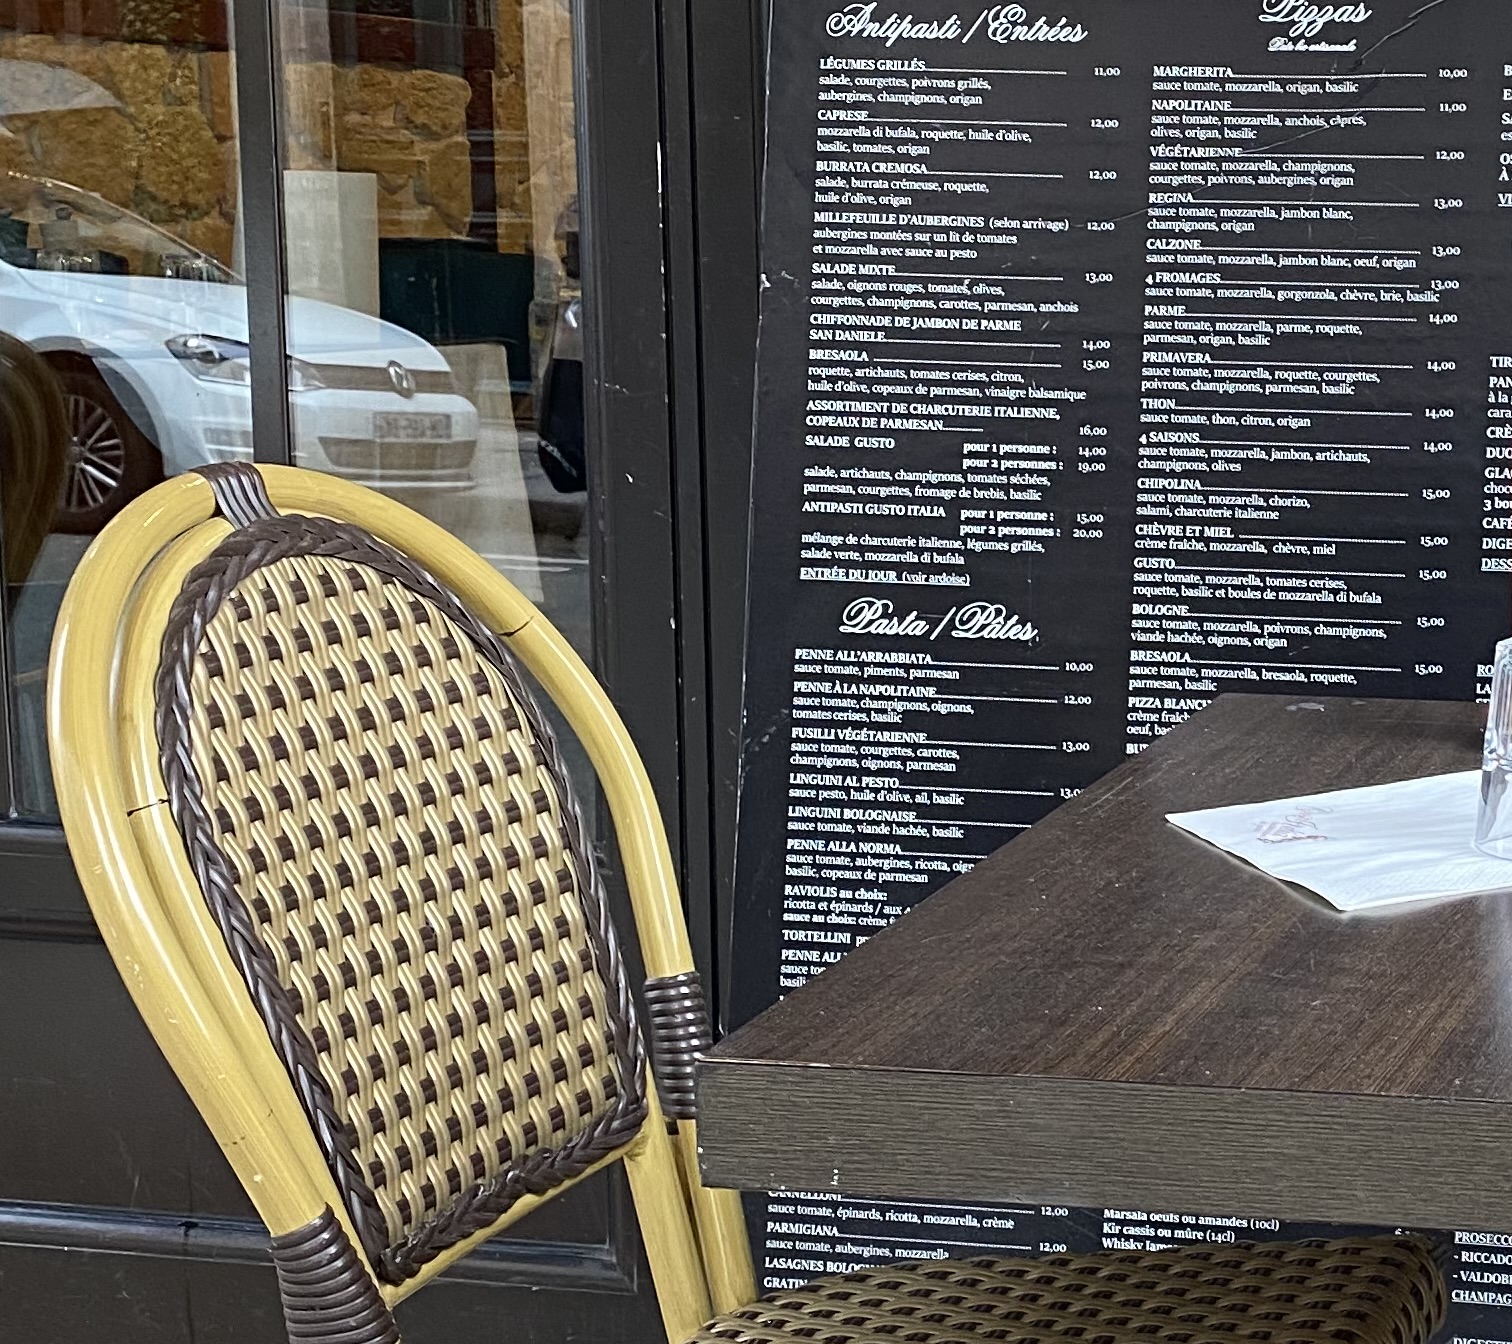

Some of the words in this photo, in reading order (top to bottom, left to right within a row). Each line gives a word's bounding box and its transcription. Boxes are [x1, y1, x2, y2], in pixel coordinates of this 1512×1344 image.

[826, 2, 961, 47] Antipasti
[987, 4, 1088, 43] Entrées
[820, 57, 875, 70] LÉGUMES
[877, 58, 925, 70] GRILLÉS
[1094, 67, 1120, 77] 11,00
[1153, 66, 1233, 77] MARGHERITA
[1439, 69, 1467, 79] 10,00
[819, 76, 853, 87] salade,
[855, 76, 909, 89] courgettes,
[912, 78, 955, 89] poivrons
[958, 78, 991, 90] grillés,
[1153, 82, 1181, 91] sauce
[1184, 80, 1222, 93] tomate,
[1225, 81, 1283, 94] mozzarella,
[1286, 82, 1322, 95] origan,
[1326, 82, 1358, 92] basilic
[1152, 100, 1231, 111] NAPOLITAINE
[1439, 103, 1467, 113] 11,00
[818, 110, 869, 120] CAPRESE
[1091, 119, 1118, 128] 12,00
[1150, 146, 1242, 157] VÉGÉTARIENNE
[1435, 151, 1464, 161] 12,00
[816, 161, 870, 173] BURRATA
[872, 163, 927, 174] CREMOSA
[1089, 170, 1116, 180] 12,00
[1149, 193, 1193, 203] REGINA
[1434, 198, 1462, 209] 13,00
[814, 212, 896, 224] MILLEFEUILLE
[899, 214, 984, 227] D'AUBERGINES
[989, 218, 1020, 229] (selon
[1022, 219, 1069, 232] arrivage)
[1147, 240, 1201, 250] CALZONE
[1432, 246, 1460, 257] 13,00
[812, 263, 856, 275] SALADE
[859, 264, 896, 275] MIXTE
[1145, 274, 1153, 286] 4
[1156, 273, 1221, 284] FROMAGES
[1139, 434, 1147, 445] 4
[1150, 432, 1200, 443] SAISONS
[1424, 441, 1452, 453] 14,00
[1137, 478, 1201, 489] CHIPOLINA
[1422, 488, 1450, 499] 15,00
[1134, 558, 1175, 569] GUSTO
[1419, 570, 1447, 580] 15,00
[839, 597, 929, 636] Pasta
[952, 602, 1038, 641] Pâtes
[795, 649, 833, 661] PENNE
[836, 650, 932, 665] ALL'ARRABBIATA
[1065, 662, 1093, 673] 10,00
[1130, 651, 1191, 662] BRESAOLA
[790, 774, 842, 786] LINGUINI
[844, 775, 859, 787] AL
[862, 776, 899, 788] PESTO
[785, 885, 837, 898] RAVIOLIS
[839, 889, 852, 899] au
[855, 887, 887, 900] choix:
[783, 930, 851, 944] TORTELLINI
[767, 1221, 838, 1237] PARMIGIANA
[1039, 1242, 1066, 1253] 12,00
